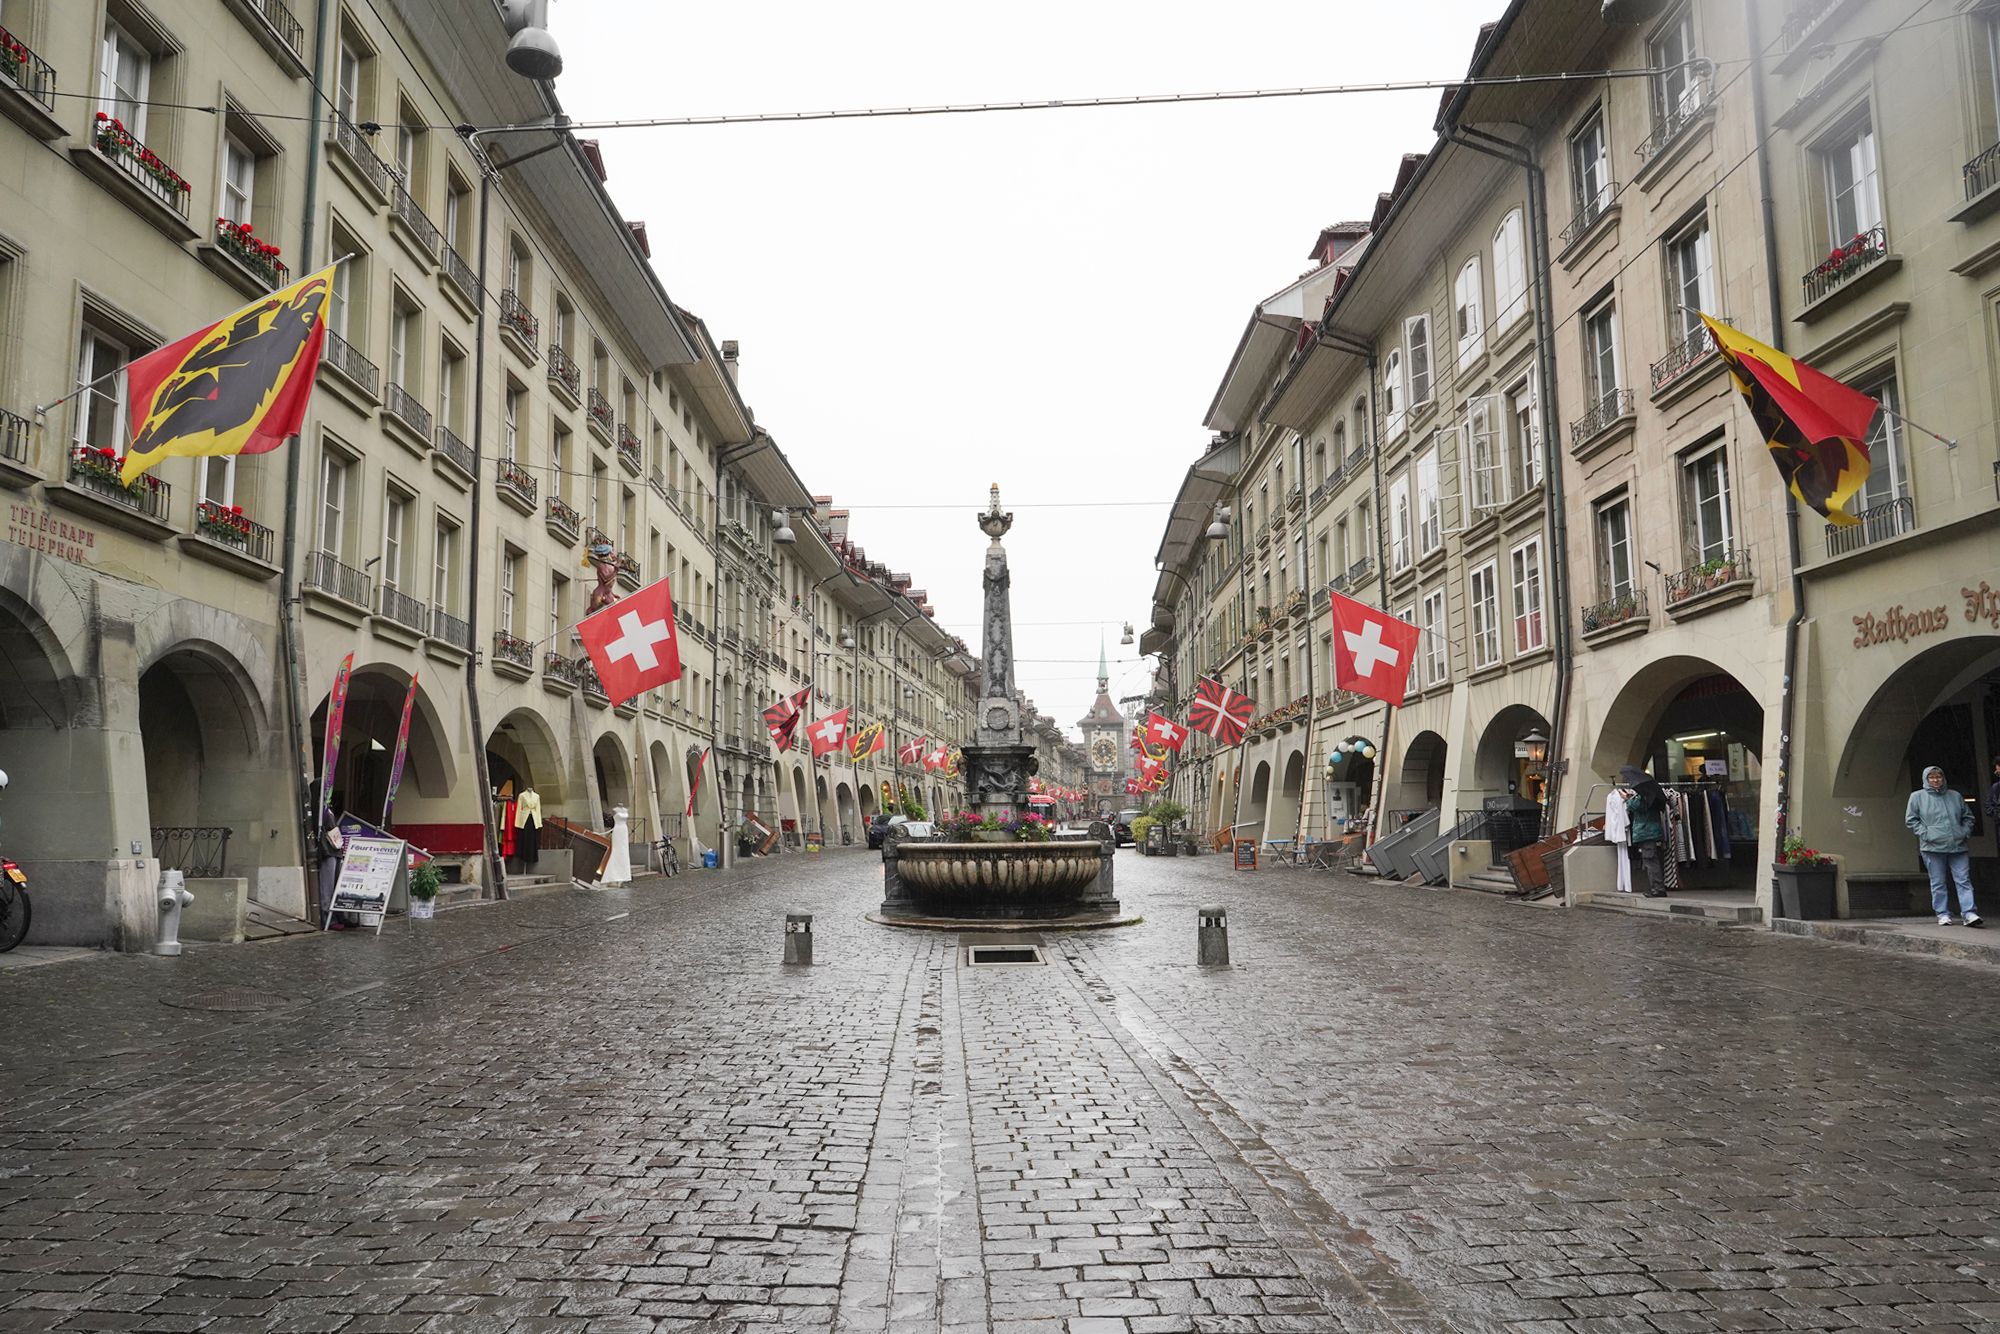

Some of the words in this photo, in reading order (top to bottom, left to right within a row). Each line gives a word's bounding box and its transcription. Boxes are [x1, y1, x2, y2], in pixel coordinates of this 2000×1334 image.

[9, 525, 84, 563] TELEPHON
[10, 504, 95, 548] TELEGRAPH
[1852, 604, 1949, 649] Rathaus
